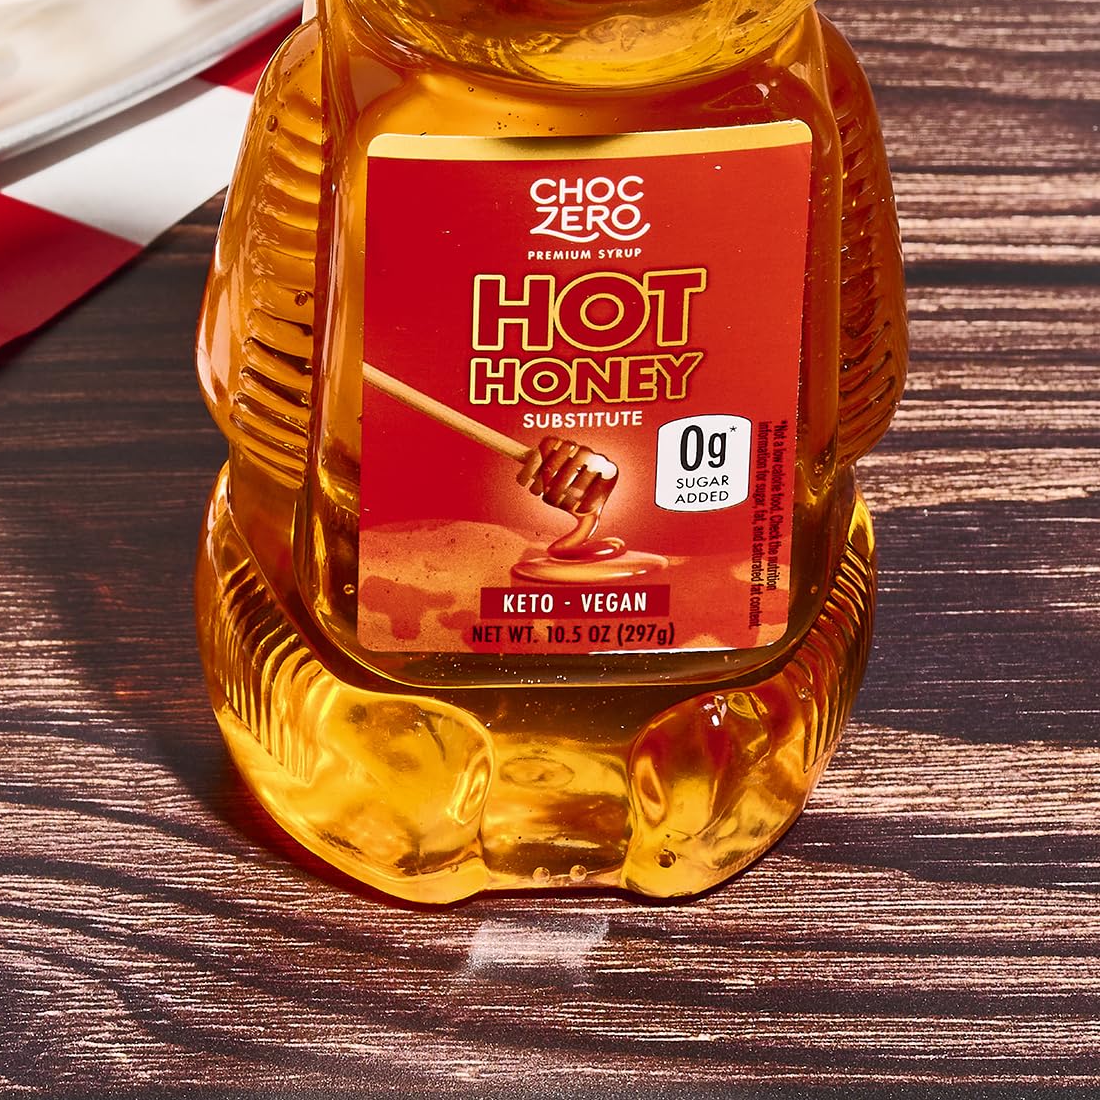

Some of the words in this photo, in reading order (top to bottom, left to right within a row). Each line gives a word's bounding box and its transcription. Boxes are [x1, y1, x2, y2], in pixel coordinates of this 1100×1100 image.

[530, 176, 644, 205] CHOC
[530, 204, 651, 243] ZERO
[527, 250, 592, 261] PREMIUM
[598, 247, 642, 259] SYRUP
[472, 267, 707, 352] HOT
[469, 352, 704, 406] HONEY
[522, 410, 643, 429] SUBSTITUTE
[756, 421, 772, 469] information
[772, 448, 786, 462] low
[676, 475, 729, 489] SUGAR
[755, 470, 770, 481] for
[771, 464, 785, 491] calorie
[675, 491, 729, 504] ADDED
[752, 483, 766, 509] sugar,
[769, 493, 784, 514] food.
[752, 509, 768, 524] fat,
[752, 525, 766, 541] and
[768, 515, 783, 540] Check
[768, 541, 782, 555] the
[751, 542, 765, 582] saturated
[766, 556, 780, 590] nutrition
[750, 583, 764, 595] fat
[503, 593, 554, 613] KETO
[581, 592, 647, 613] VEGAN
[472, 626, 503, 643] NET
[509, 625, 538, 643] WT.
[547, 625, 581, 643] 10.5
[589, 625, 611, 643] OZ
[617, 622, 675, 646] (297g)
